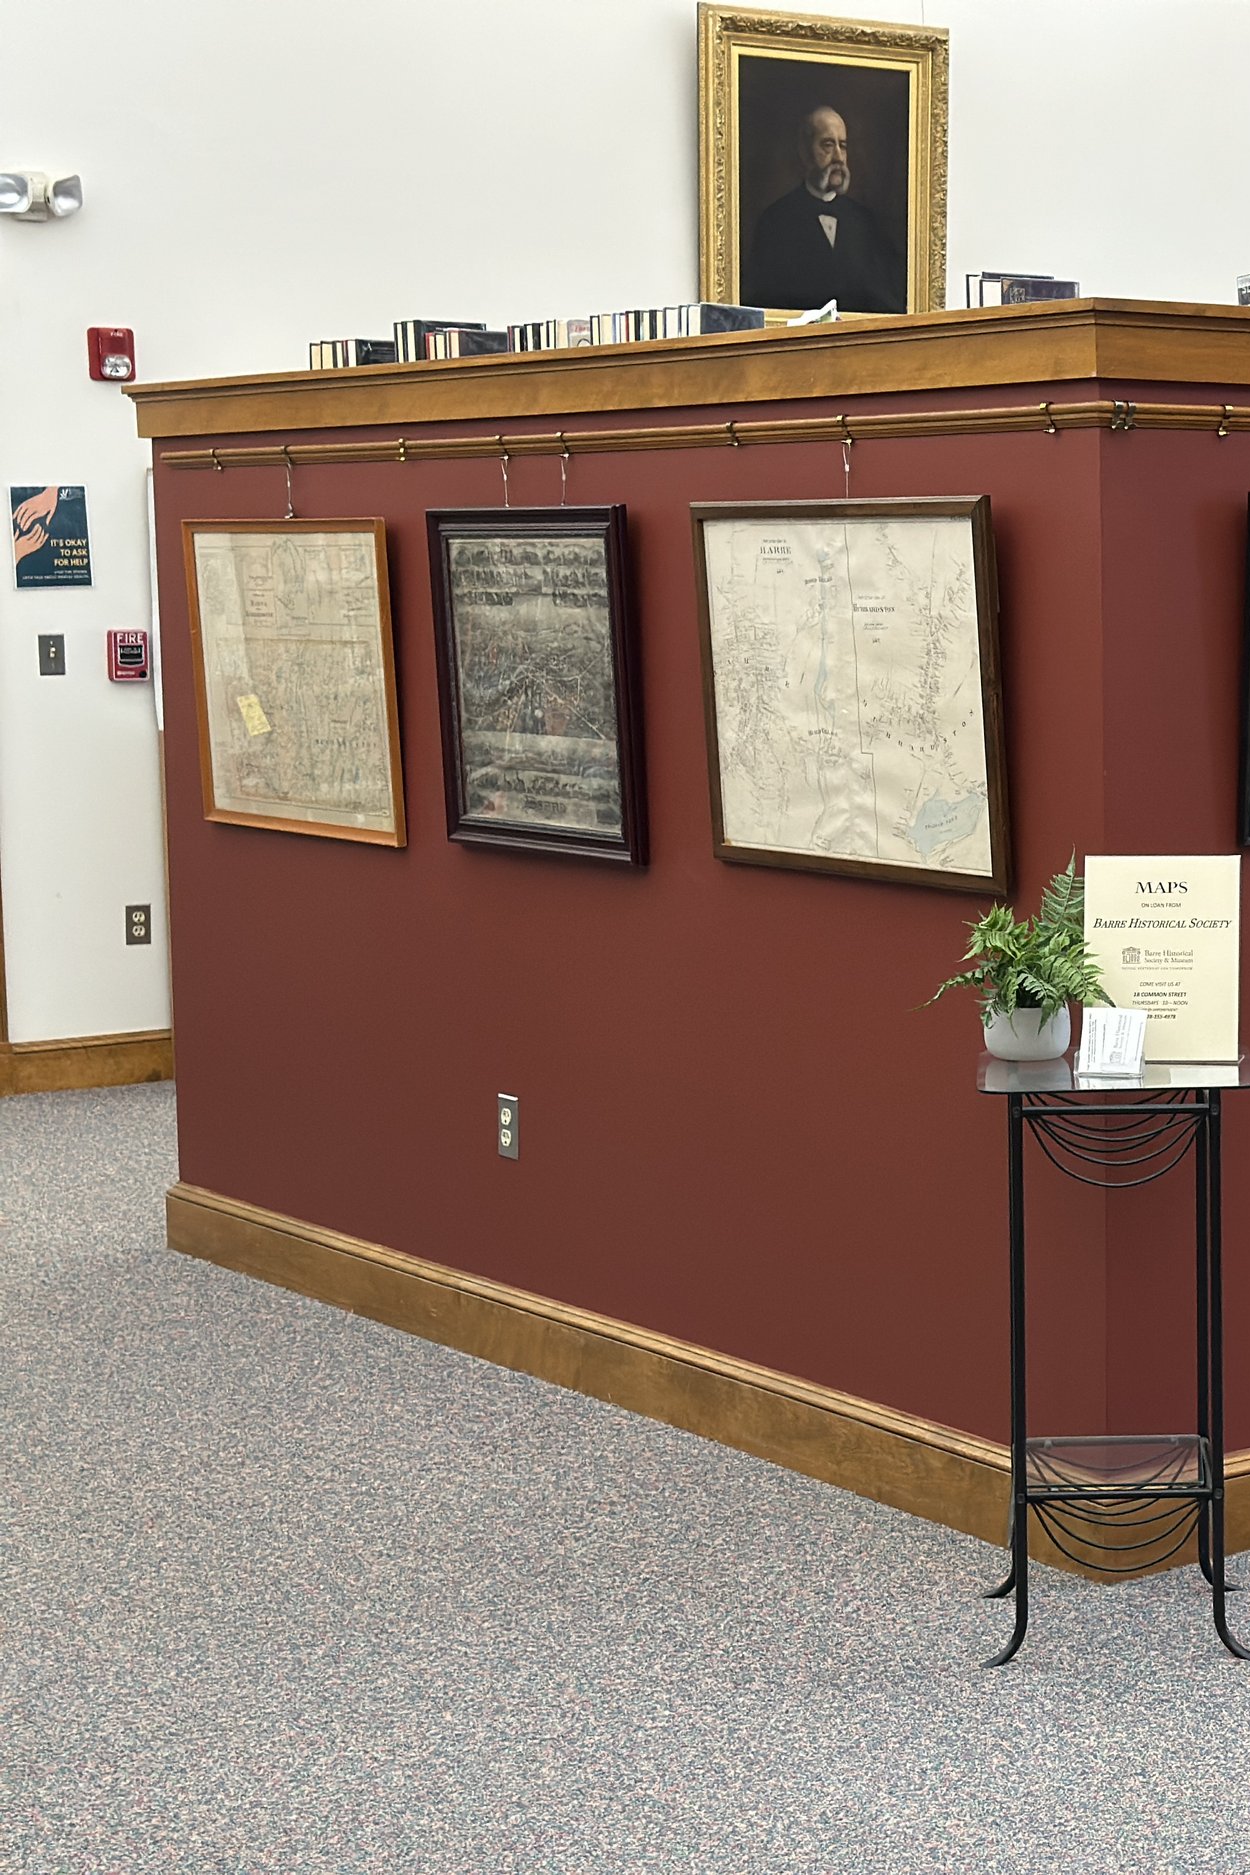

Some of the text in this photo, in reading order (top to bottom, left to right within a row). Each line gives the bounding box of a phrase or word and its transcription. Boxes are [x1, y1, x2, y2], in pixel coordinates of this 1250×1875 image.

[50, 538, 87, 547] IT'S OKAY
[117, 632, 144, 644] FIRE
[1135, 881, 1188, 894] MAPS
[1093, 918, 1232, 929] BARRE HISTORICAL SOCIETY
[1144, 949, 1194, 957] Barre Historical
[1144, 957, 1163, 965] Society
